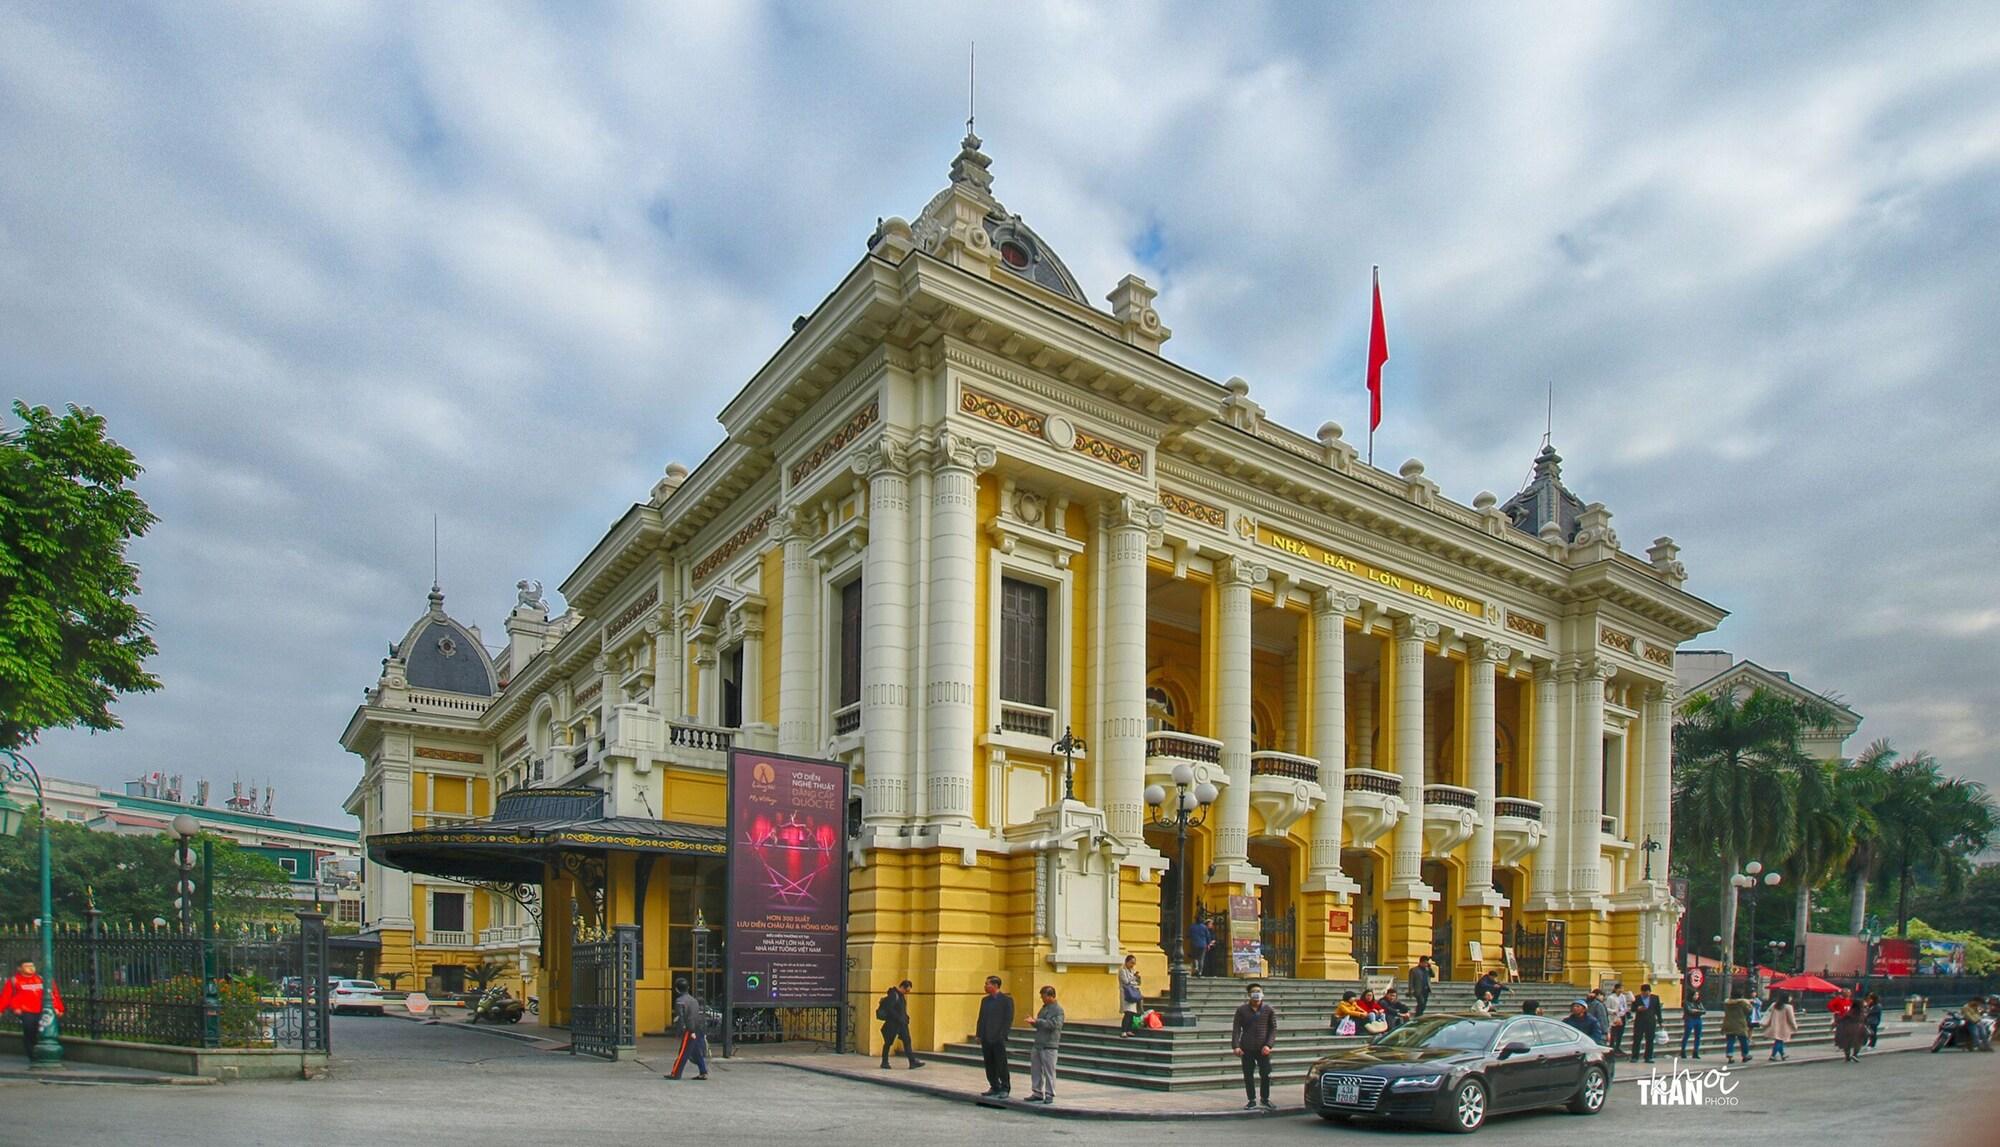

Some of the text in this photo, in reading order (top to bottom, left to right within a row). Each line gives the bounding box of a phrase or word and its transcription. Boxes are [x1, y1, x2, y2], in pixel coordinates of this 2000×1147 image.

[1272, 535, 1470, 612] NHÀ HÁT LỚN HÀ NỘI
